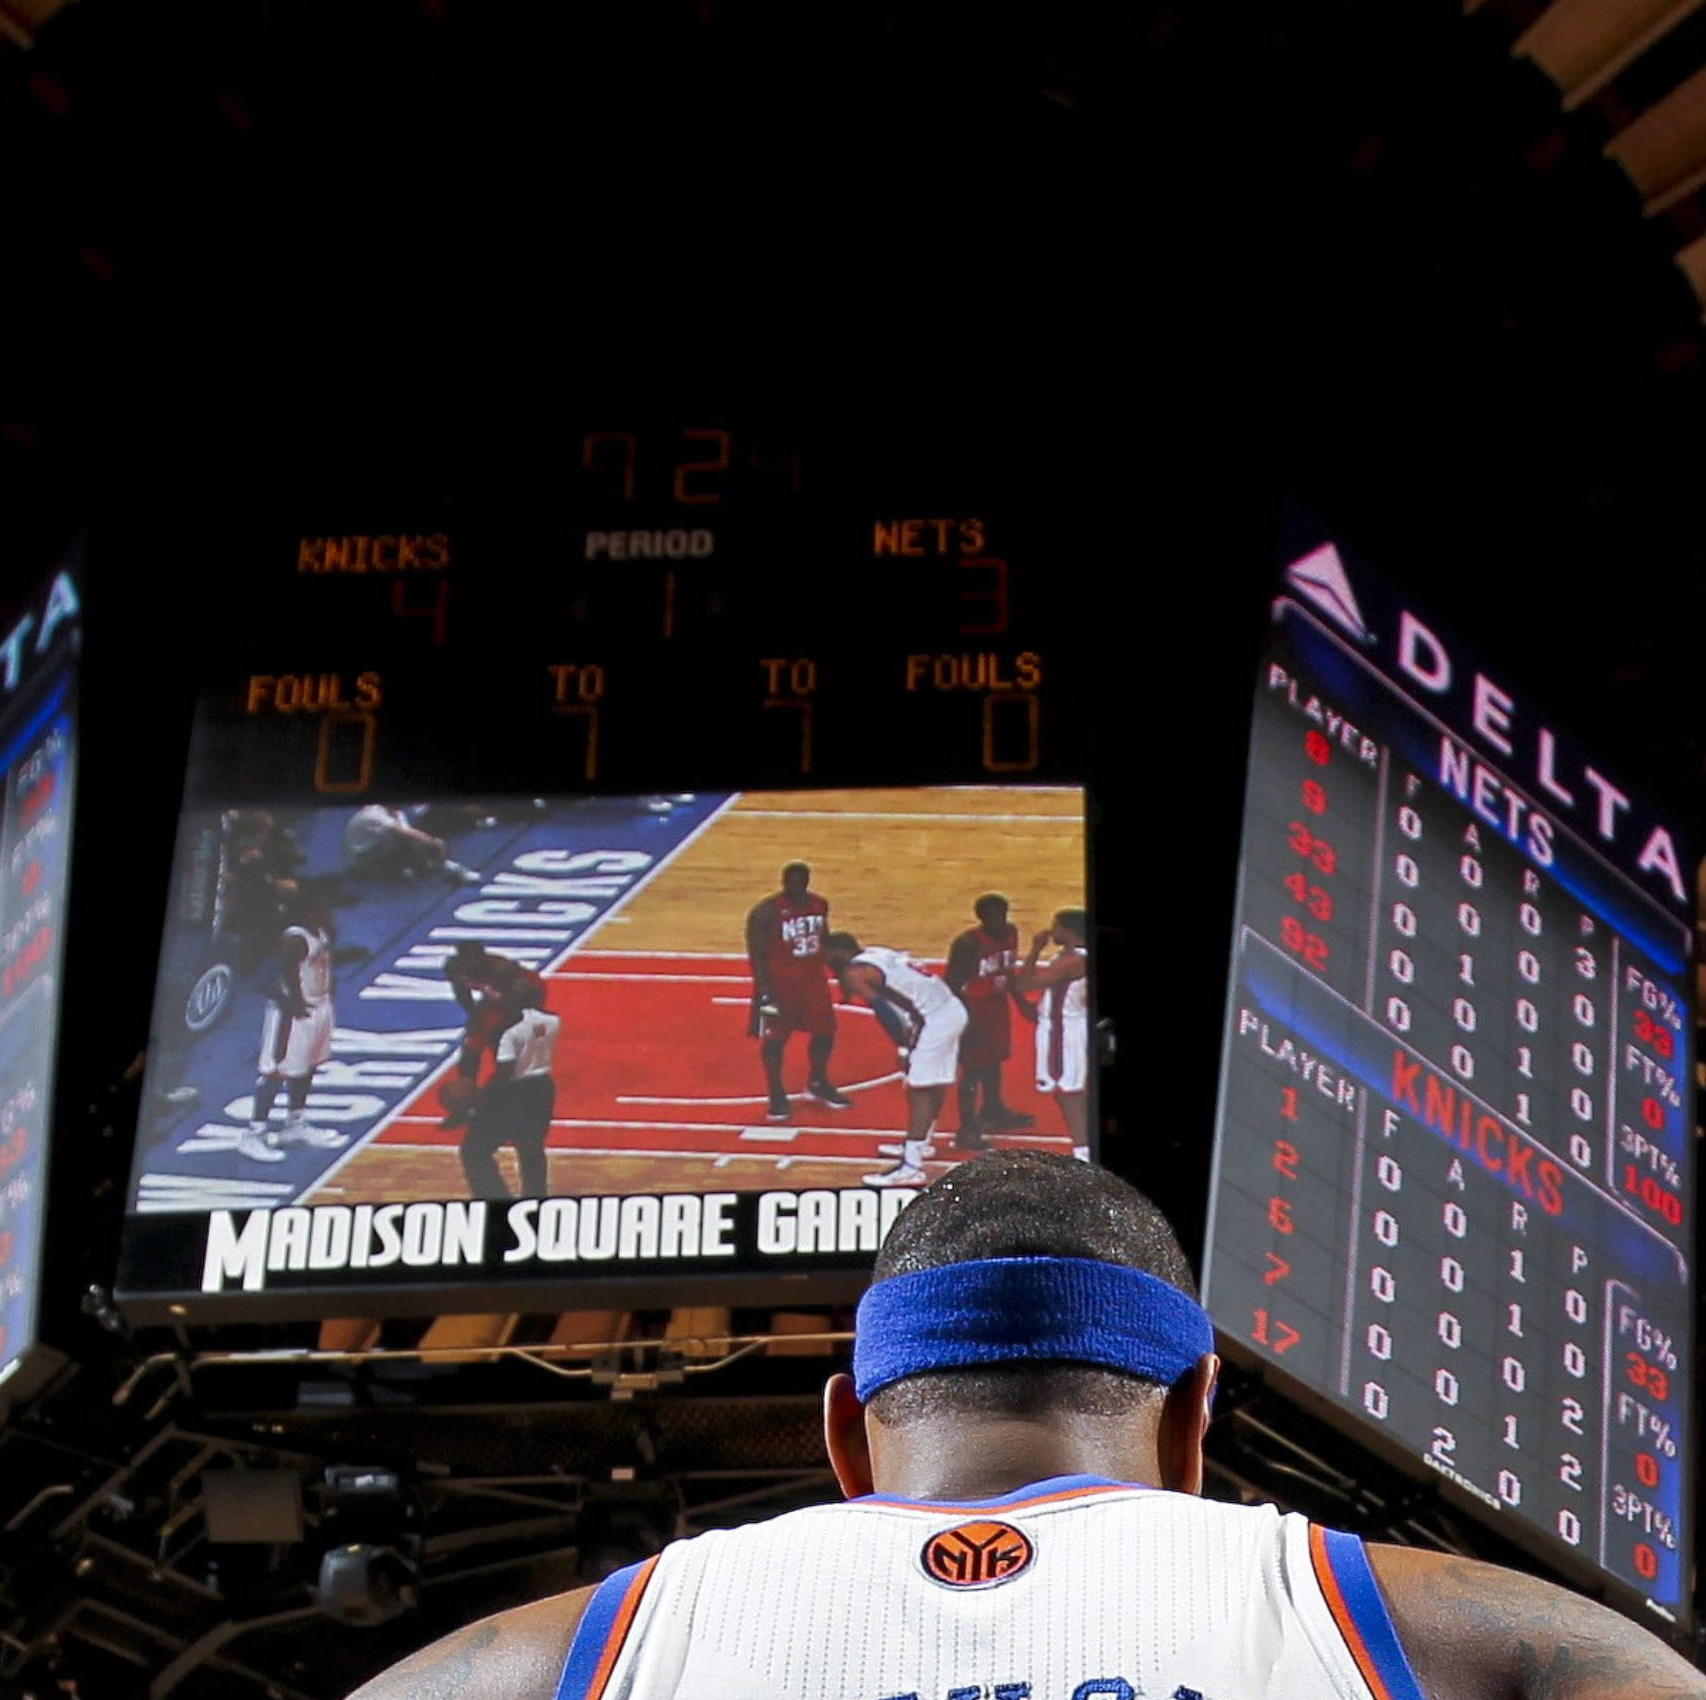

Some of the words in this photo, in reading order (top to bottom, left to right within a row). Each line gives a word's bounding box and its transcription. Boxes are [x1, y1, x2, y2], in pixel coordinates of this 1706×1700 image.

[296, 531, 452, 576] KNICKS
[584, 528, 715, 562] PERIOD
[873, 515, 986, 557] NETS
[390, 577, 449, 647] 4
[957, 556, 1010, 637] 3
[246, 670, 383, 716] FOULS
[547, 663, 605, 702] TO
[759, 656, 819, 697] TO
[904, 649, 1045, 695] FOULS
[1269, 662, 1377, 769] PLAYER
[1399, 610, 1688, 904] DELTA
[1440, 736, 1554, 867] NETS
[1399, 806, 1422, 839] 0
[1461, 855, 1483, 887] 0
[1520, 902, 1542, 936] 0
[1393, 903, 1417, 936] 0
[1460, 954, 1475, 986] 1
[1516, 999, 1538, 1032] 0
[1572, 1042, 1593, 1075] 0
[1397, 854, 1419, 887] 0
[1459, 903, 1481, 936] 0
[1518, 950, 1540, 984] 0
[1573, 994, 1595, 1027] 0
[1388, 997, 1410, 1031] 0
[1451, 1045, 1474, 1079] 0
[1516, 1094, 1532, 1126] 1
[1569, 1134, 1590, 1168] 0
[1391, 949, 1414, 983] 0
[1453, 998, 1476, 1032] 0
[1518, 1047, 1533, 1078] 1
[1571, 1087, 1592, 1121] 0
[1239, 1008, 1356, 1112] PLAYER
[1384, 1109, 1401, 1138] F
[1447, 1158, 1465, 1190] A
[1512, 1201, 1528, 1235] R
[1573, 1245, 1588, 1274] P
[1393, 1050, 1564, 1217] KNICKS
[1625, 1164, 1683, 1226] 100
[201, 1200, 487, 1293] MADISON
[506, 1194, 736, 1264] SQUARE
[1273, 1140, 1300, 1180] 2
[1374, 1210, 1399, 1247] 0
[1441, 1256, 1464, 1293] 0
[1508, 1303, 1524, 1338] 1
[1564, 1342, 1585, 1378] 0
[1282, 1086, 1300, 1121] 1
[1377, 1155, 1402, 1191] 0
[1443, 1202, 1467, 1238] 0
[1510, 1250, 1526, 1283] 1
[1565, 1289, 1587, 1324] 0
[1263, 1251, 1290, 1286] 7
[1367, 1323, 1392, 1360] 0
[1435, 1368, 1459, 1406] 0
[1504, 1414, 1520, 1449] 1
[1560, 1452, 1582, 1491] 2
[1268, 1195, 1295, 1235] 6
[1371, 1266, 1395, 1303] 0
[1438, 1311, 1461, 1348] 0
[1503, 1357, 1525, 1393] 0
[1562, 1398, 1584, 1435] 2
[1619, 1305, 1677, 1371] FG%
[1626, 1352, 1668, 1400] 33
[1251, 1308, 1301, 1354] 17
[1364, 1381, 1388, 1420] 0
[1432, 1426, 1456, 1466] 2
[1498, 1469, 1521, 1506] 0
[1558, 1508, 1580, 1546] 0
[1617, 1392, 1676, 1458] FT%
[1635, 1452, 1659, 1487] 0
[1612, 1484, 1676, 1550] 3PT%
[1633, 1542, 1658, 1579] 0
